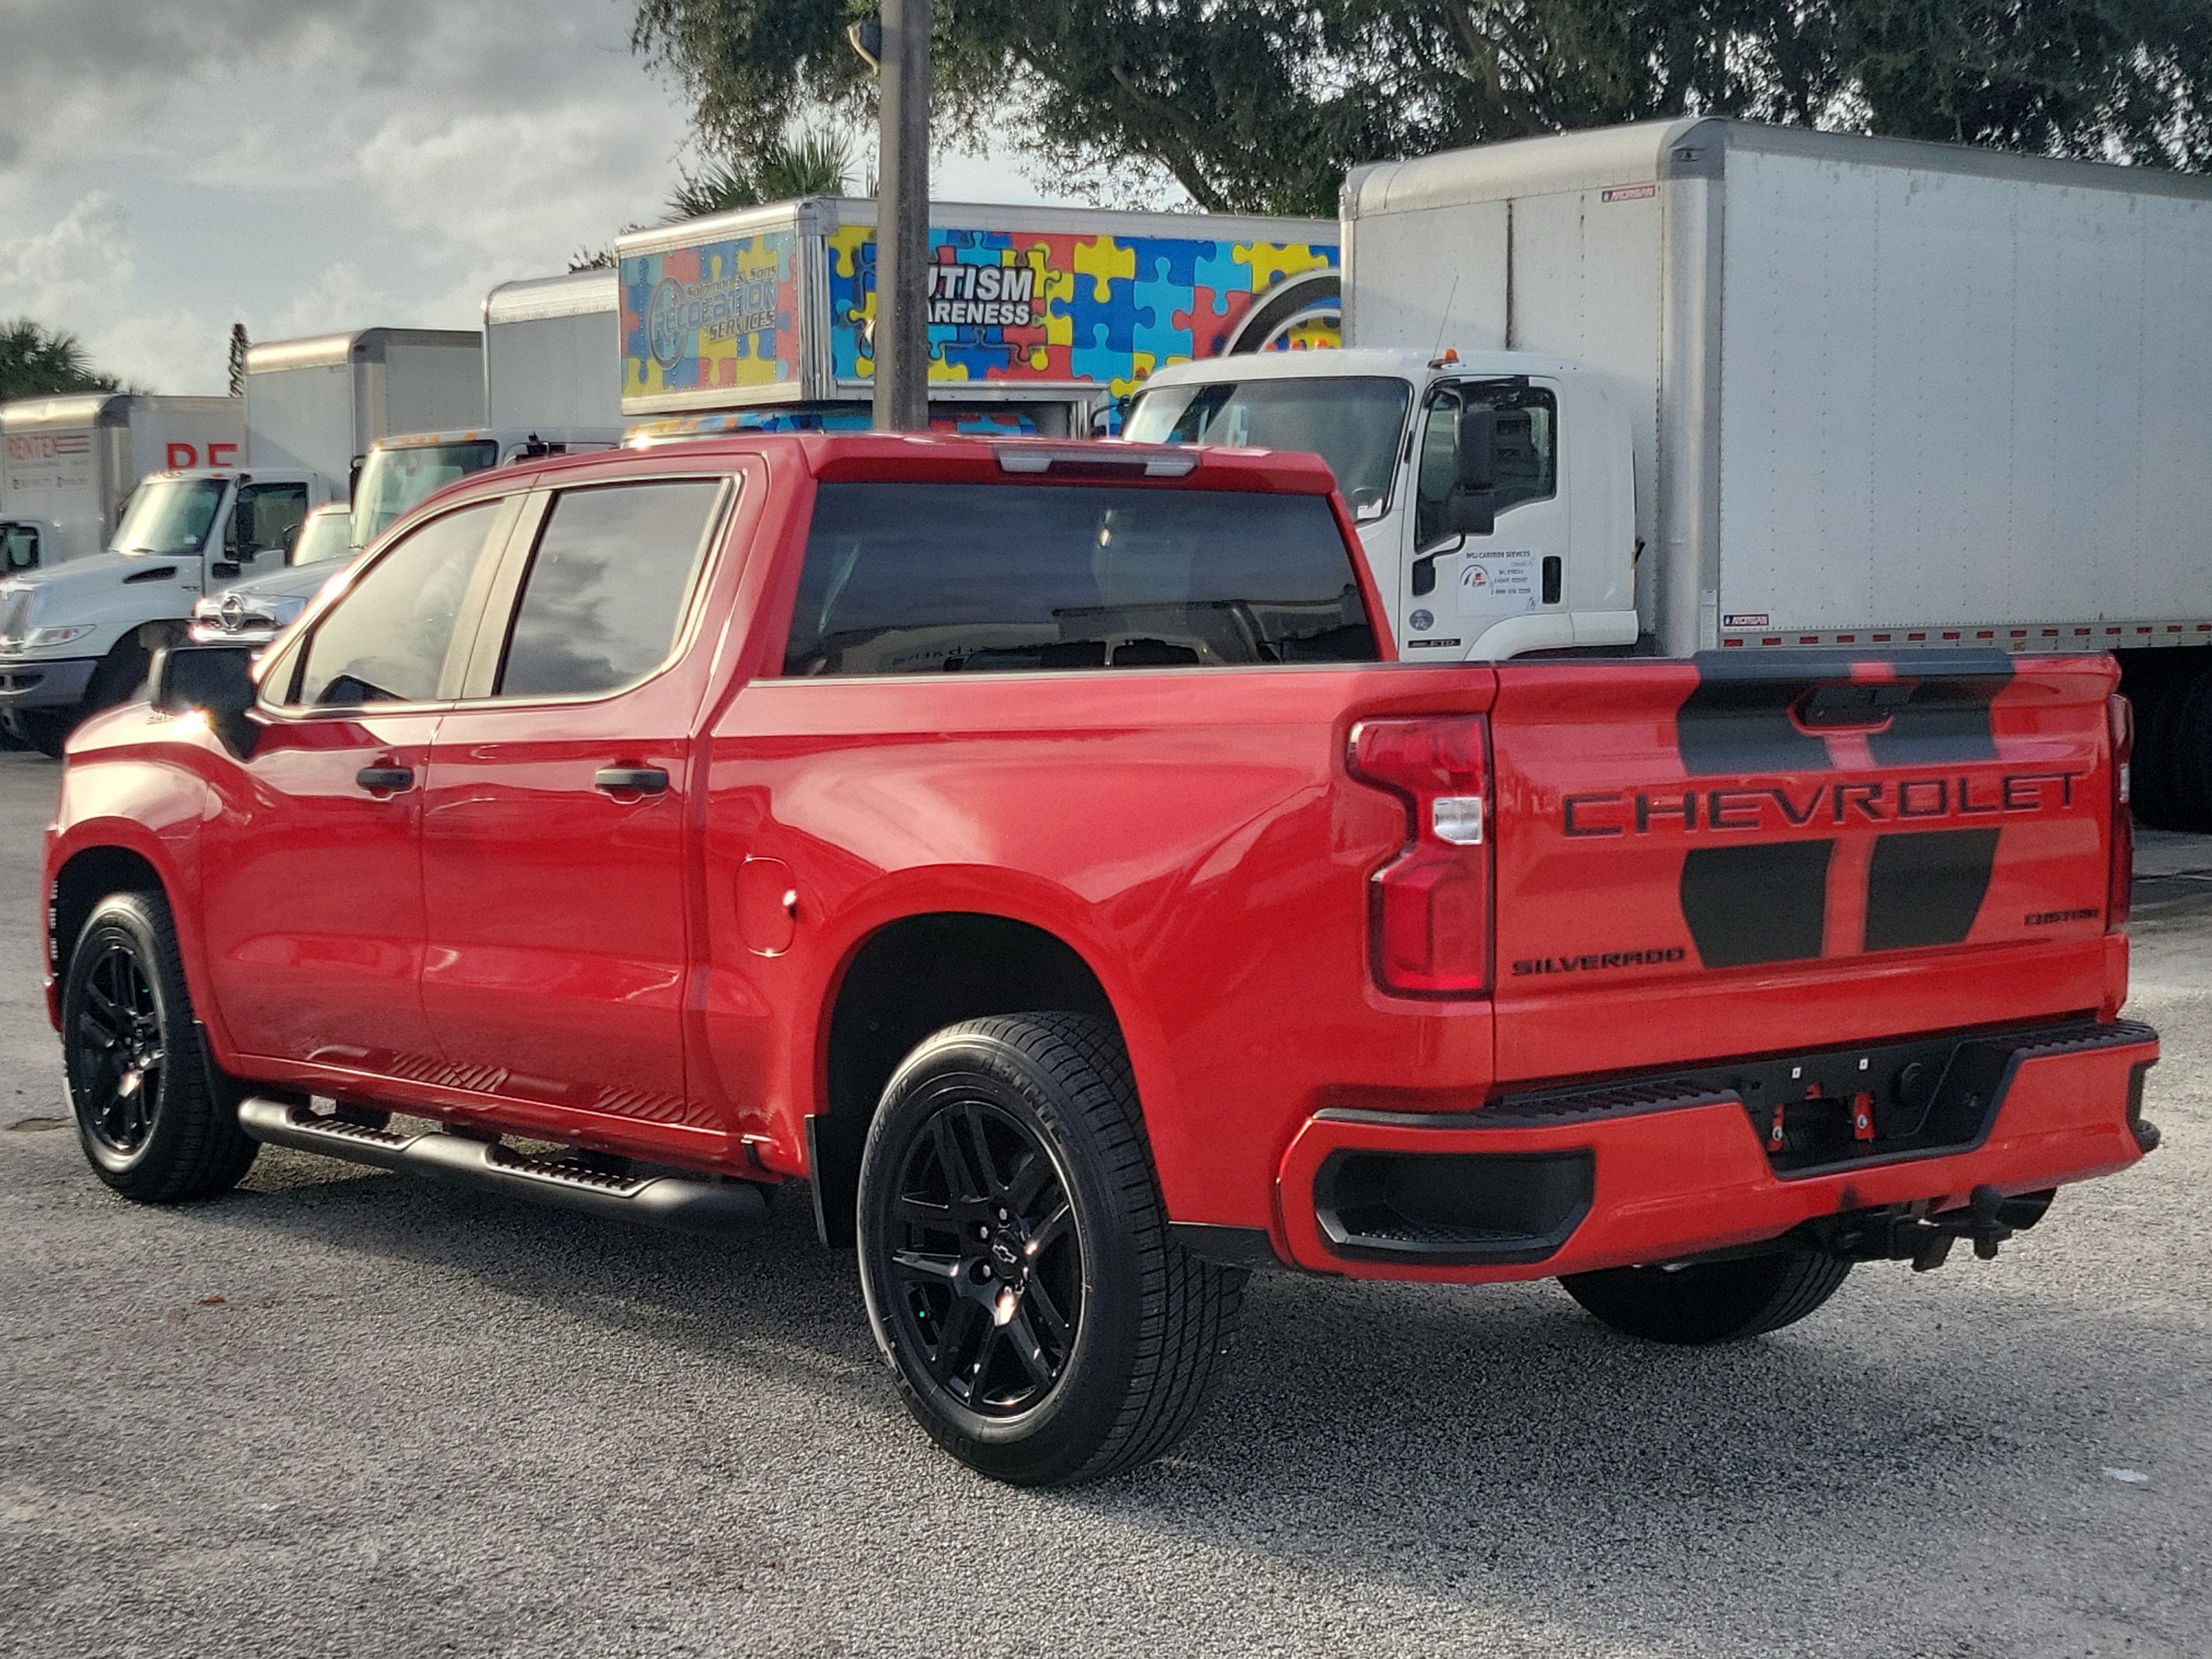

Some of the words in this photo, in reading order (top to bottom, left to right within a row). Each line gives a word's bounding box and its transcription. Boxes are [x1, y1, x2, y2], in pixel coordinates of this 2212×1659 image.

[687, 278, 735, 297] Solomon
[750, 266, 777, 280] Sons
[709, 311, 776, 341] SERVICES
[1563, 771, 2085, 837] CHEVROLET
[1511, 946, 1686, 977] SILVERADO
